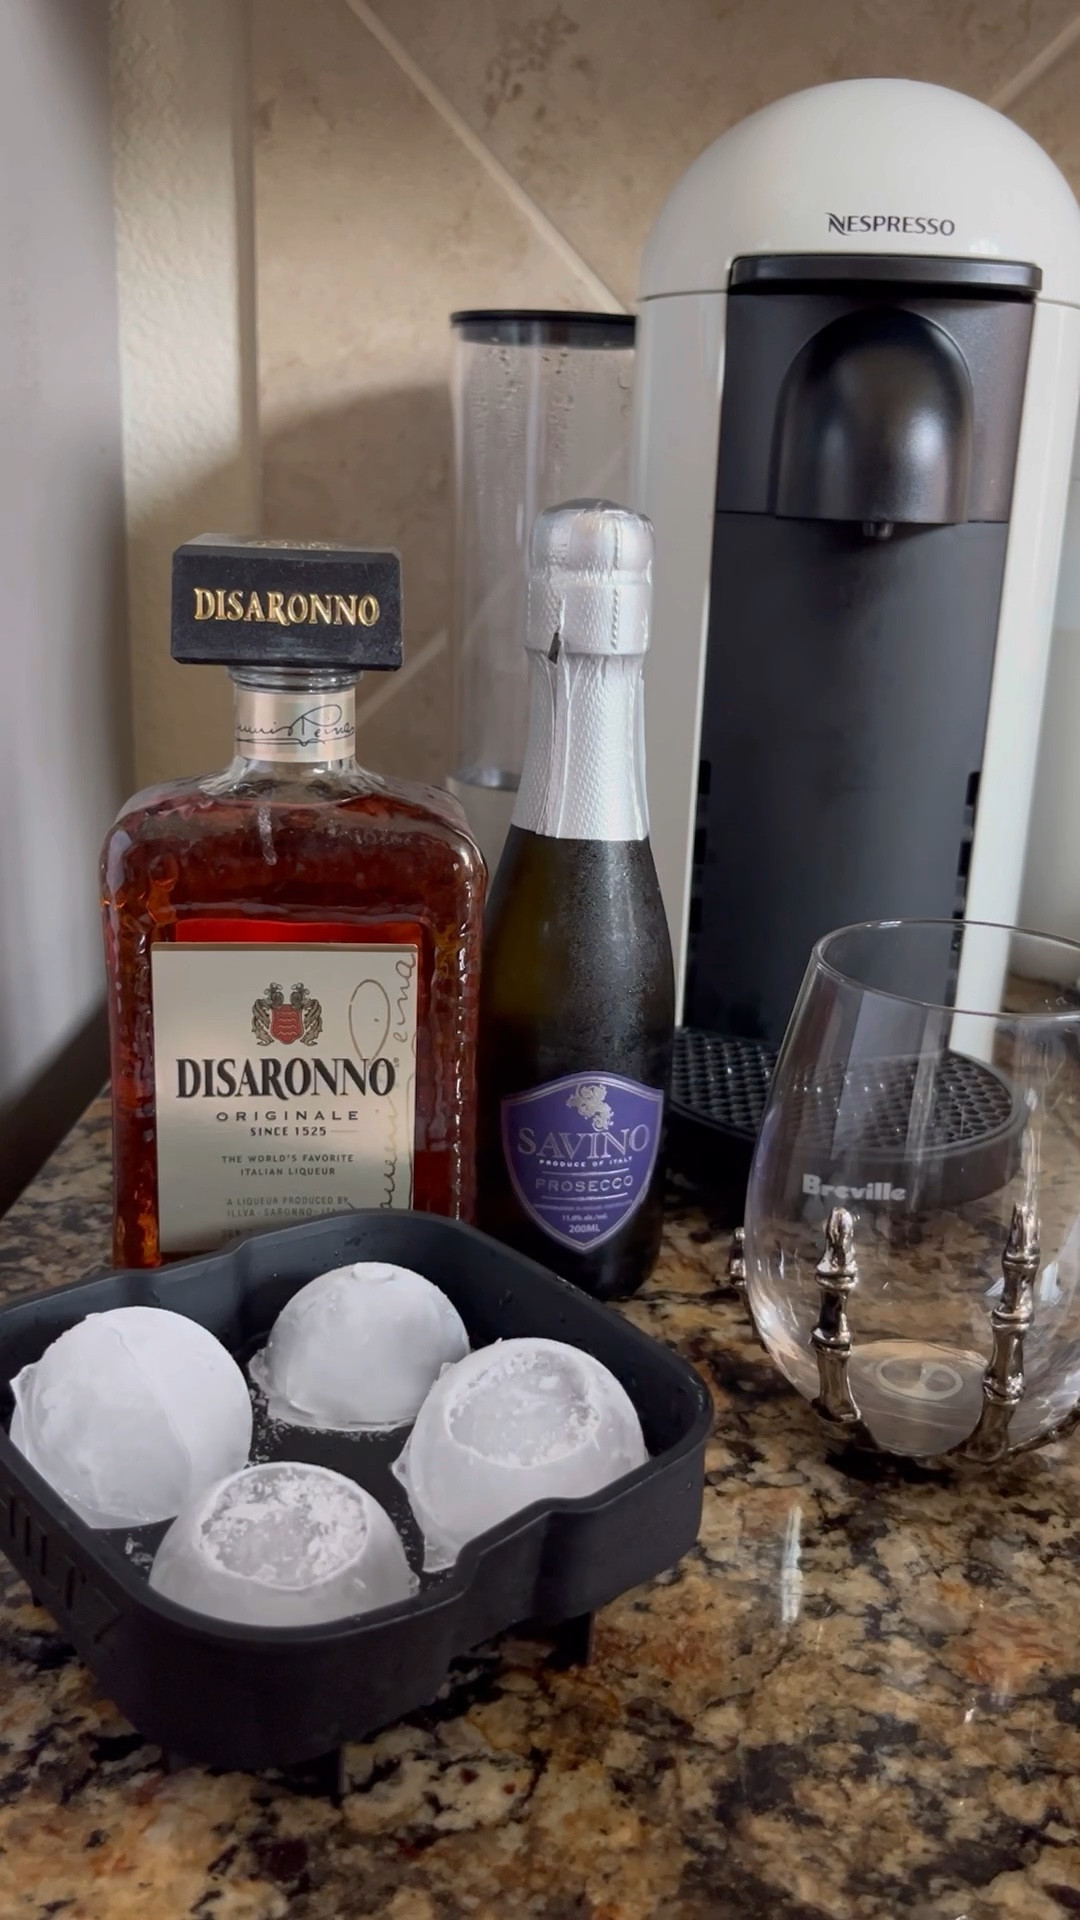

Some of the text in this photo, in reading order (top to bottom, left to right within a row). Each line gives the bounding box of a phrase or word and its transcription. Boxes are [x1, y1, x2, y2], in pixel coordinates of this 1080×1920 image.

[824, 212, 955, 236] NESPRESSO
[193, 587, 380, 626] DISARONNO
[176, 1057, 396, 1100] DISARONNO
[216, 1110, 359, 1122] ORIGINALE
[250, 1126, 327, 1137] SINCE 1525
[517, 1124, 650, 1160] SAVINO
[222, 1154, 354, 1163] THE WORLD'S FAVORITE
[539, 1156, 633, 1168] PRODUCE OF ITALY
[240, 1167, 336, 1176] ITALIAN LIQUEUR
[535, 1175, 634, 1192] PROSECCO
[802, 1173, 907, 1201] Breville
